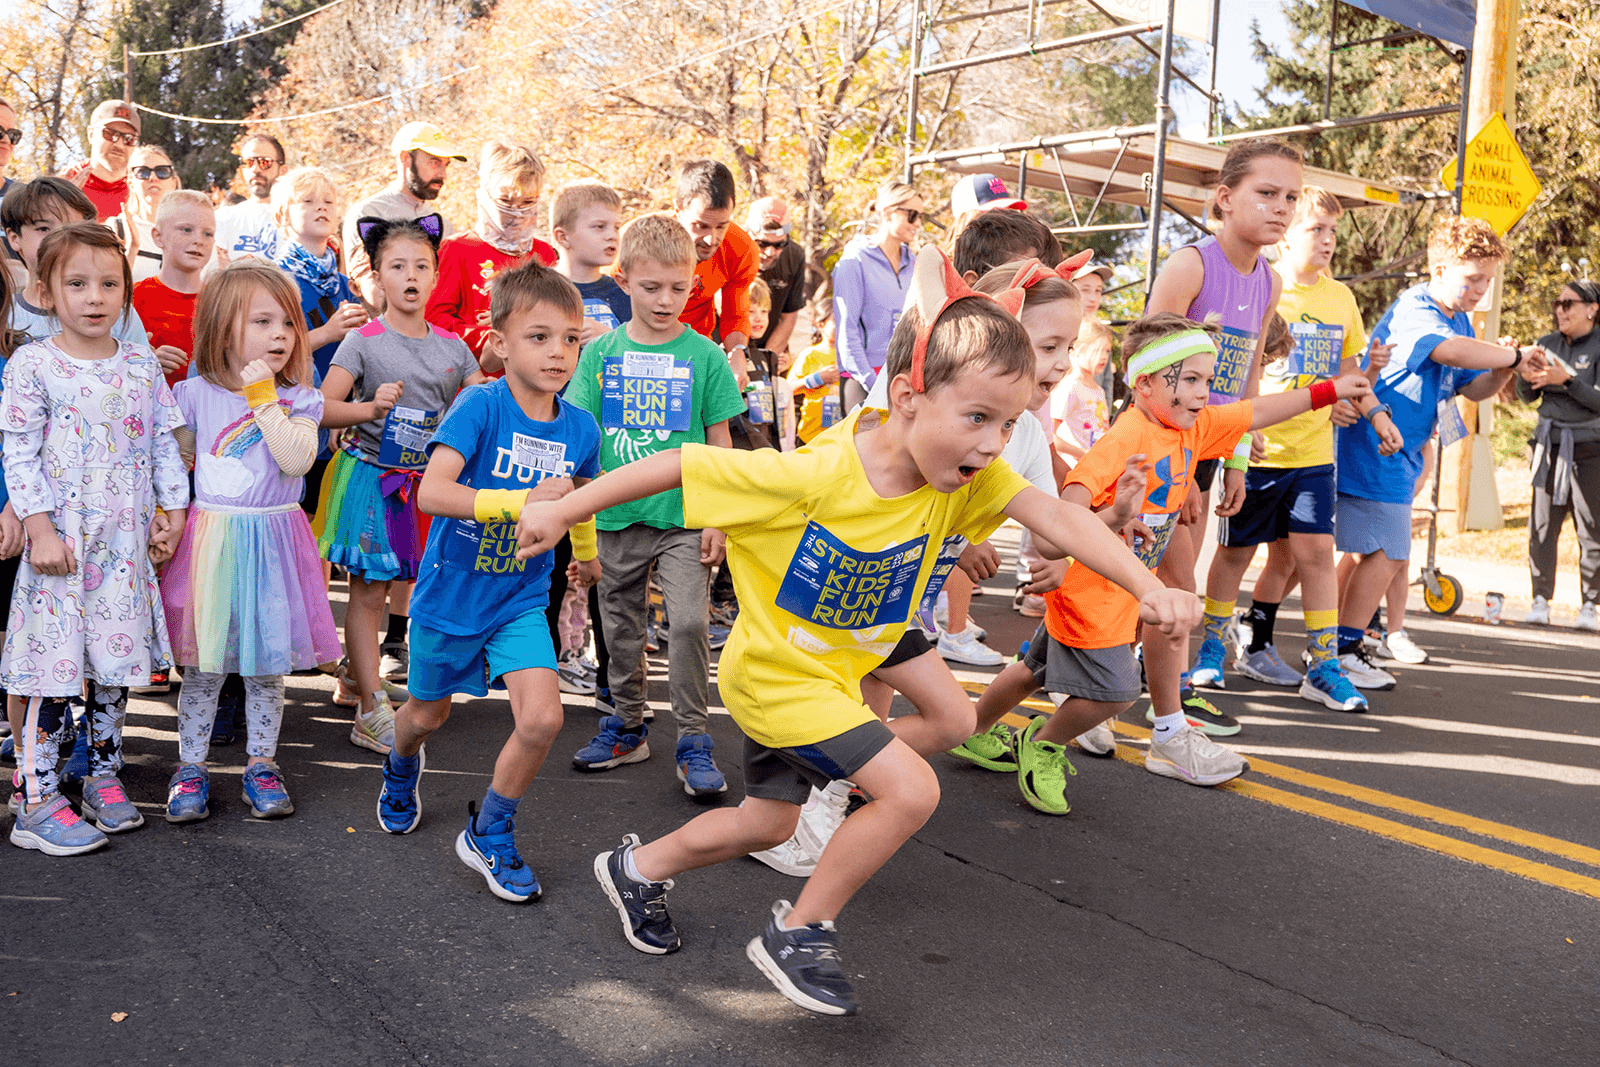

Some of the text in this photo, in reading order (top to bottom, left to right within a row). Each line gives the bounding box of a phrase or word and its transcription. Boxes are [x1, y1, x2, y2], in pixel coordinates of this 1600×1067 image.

[1475, 139, 1514, 163] SMALL
[1470, 161, 1514, 187] ANIMAL
[1462, 183, 1522, 210] CROSSING
[1214, 332, 1251, 350] STRIDE
[1304, 339, 1332, 350] KIDS
[1222, 347, 1249, 365] KIDS
[1303, 350, 1330, 361] FUN
[1218, 361, 1246, 380] FUN
[1303, 362, 1329, 373] RUN
[624, 379, 667, 395] KIDS
[1212, 376, 1239, 394] RUN
[623, 394, 666, 410] FUN
[623, 410, 665, 426] RUN
[524, 438, 548, 450] RUNNING
[483, 521, 519, 540] KID
[804, 532, 817, 550] THE
[811, 538, 895, 575] STRIDE
[903, 545, 924, 564] 30
[474, 554, 527, 574] RUN
[825, 569, 893, 593] KIDS
[818, 586, 886, 610] FUN
[811, 603, 879, 627] RUN
